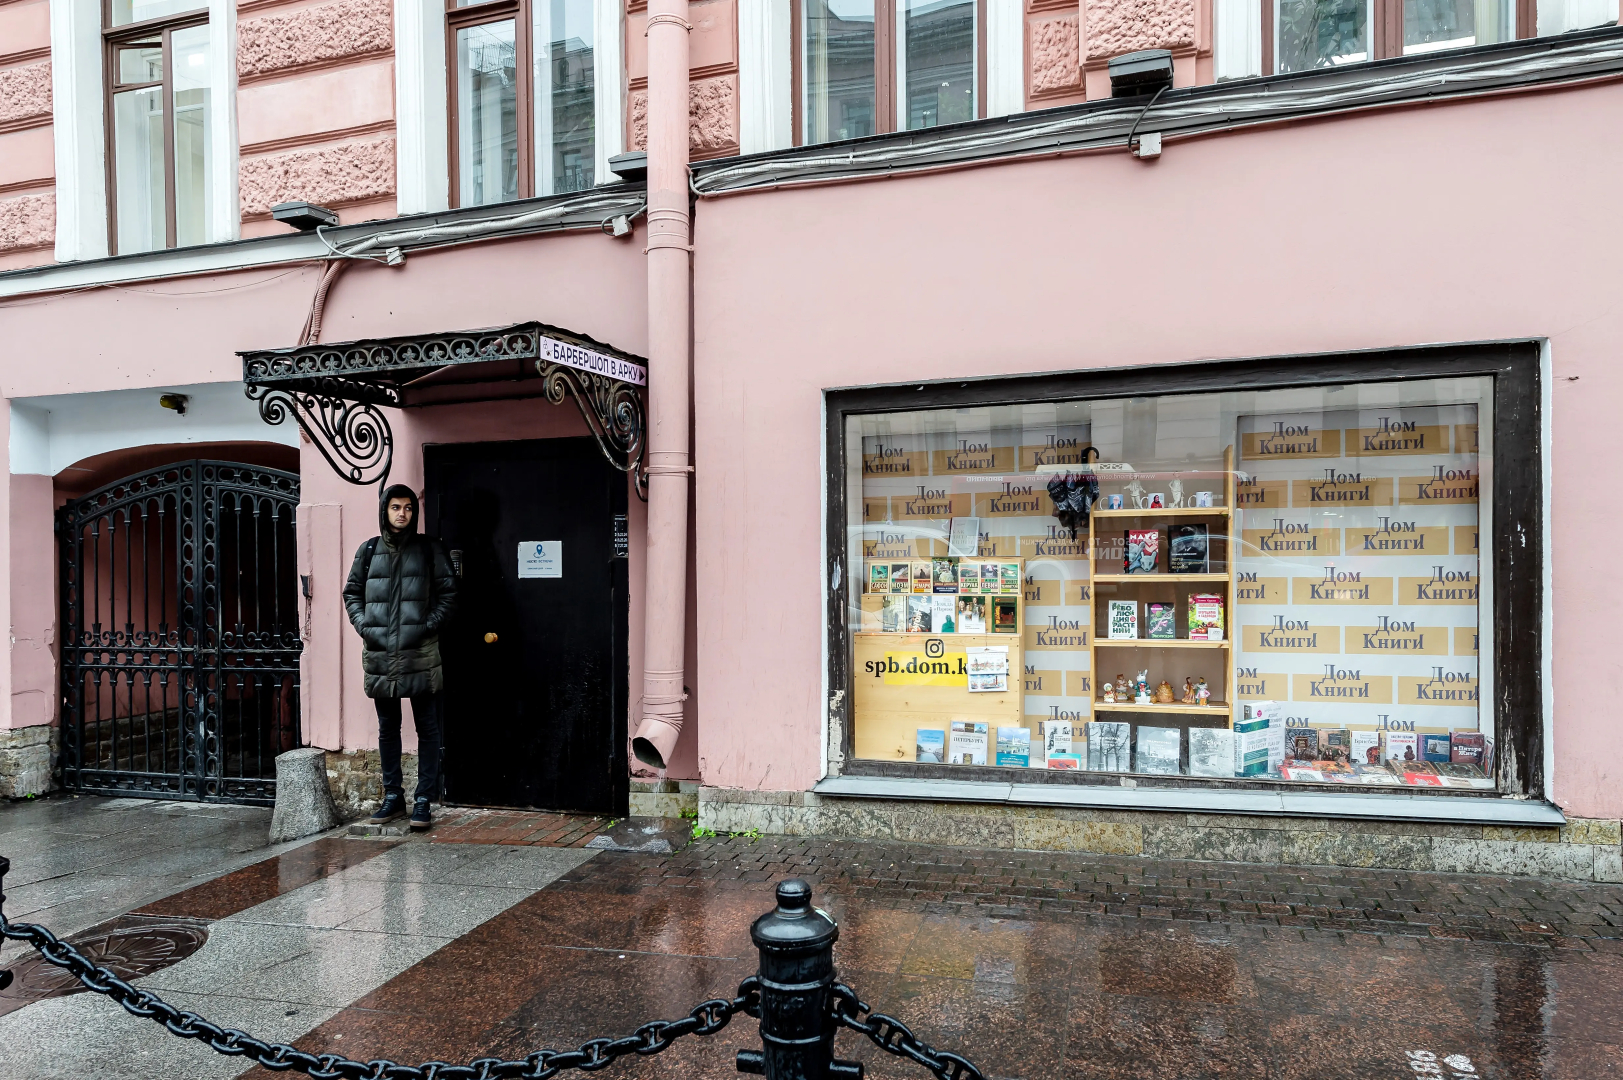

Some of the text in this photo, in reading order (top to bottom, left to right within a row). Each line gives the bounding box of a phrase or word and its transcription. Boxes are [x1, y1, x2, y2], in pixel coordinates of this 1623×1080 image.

[553, 343, 639, 381] БАРБЕРШОП В АРКУ
[1271, 421, 1310, 441] Дом
[1376, 417, 1416, 437] Дом
[957, 440, 988, 458] Дом
[1045, 434, 1077, 452] Дом
[1259, 437, 1318, 454] Книги
[1363, 434, 1425, 451] Книги
[874, 444, 904, 461] Дом
[1034, 449, 1083, 465] Книги
[865, 458, 910, 473] Книги
[947, 454, 995, 470] Книги
[1237, 475, 1257, 487] ом
[1322, 468, 1361, 488] Дом
[1431, 465, 1471, 485] Дом
[915, 485, 945, 503] Дом
[1000, 482, 1032, 500] Дом
[1237, 488, 1265, 503] иги
[1310, 485, 1370, 502] Книги
[1417, 483, 1478, 500] Книги
[905, 500, 952, 515] Книги
[990, 497, 1039, 512] Книги
[1046, 525, 1078, 543] Дом
[1271, 518, 1310, 538] Дом
[1376, 516, 1416, 536] Дом
[876, 531, 905, 547] Дом
[1259, 535, 1317, 551] Книги
[1363, 534, 1425, 550] Книги
[866, 544, 911, 557] Книги
[1035, 540, 1085, 556] Книги
[1237, 571, 1258, 583] ом
[1322, 566, 1361, 586] Дом
[1429, 565, 1471, 586] Дом
[1310, 583, 1370, 599] Книги
[1417, 583, 1478, 600] Книги
[1047, 615, 1079, 633] Дом
[1271, 615, 1309, 635] Дом
[1376, 616, 1416, 636] Дом
[1036, 631, 1087, 646] Книги
[1259, 632, 1317, 648] Книги
[1362, 633, 1424, 650] Книги
[1237, 667, 1258, 678] ом
[1322, 664, 1361, 684] Дом
[1429, 666, 1470, 687] Дом
[1310, 681, 1369, 698] Книги
[1416, 683, 1478, 701] Книги
[1048, 705, 1080, 721] Дом
[1285, 716, 1309, 728] ом
[1376, 714, 1415, 732] Дом
